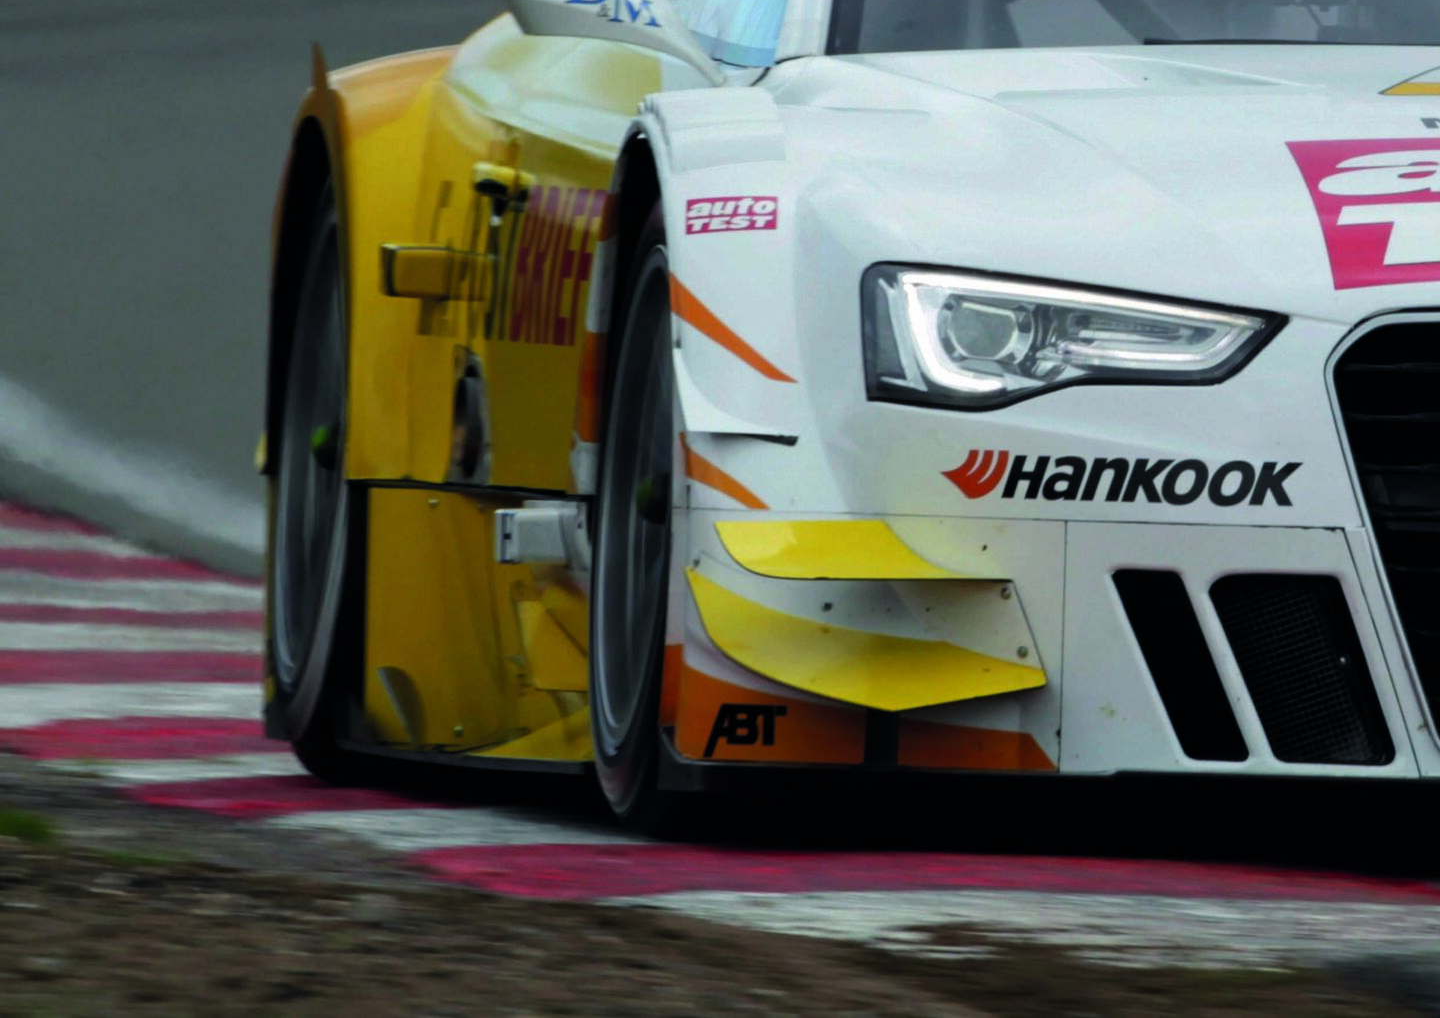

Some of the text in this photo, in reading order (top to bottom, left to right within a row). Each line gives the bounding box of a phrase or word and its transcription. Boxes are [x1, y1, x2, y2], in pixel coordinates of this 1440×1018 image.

[687, 197, 777, 218] auto
[687, 214, 775, 233] TEST
[703, 703, 787, 758] ABT
